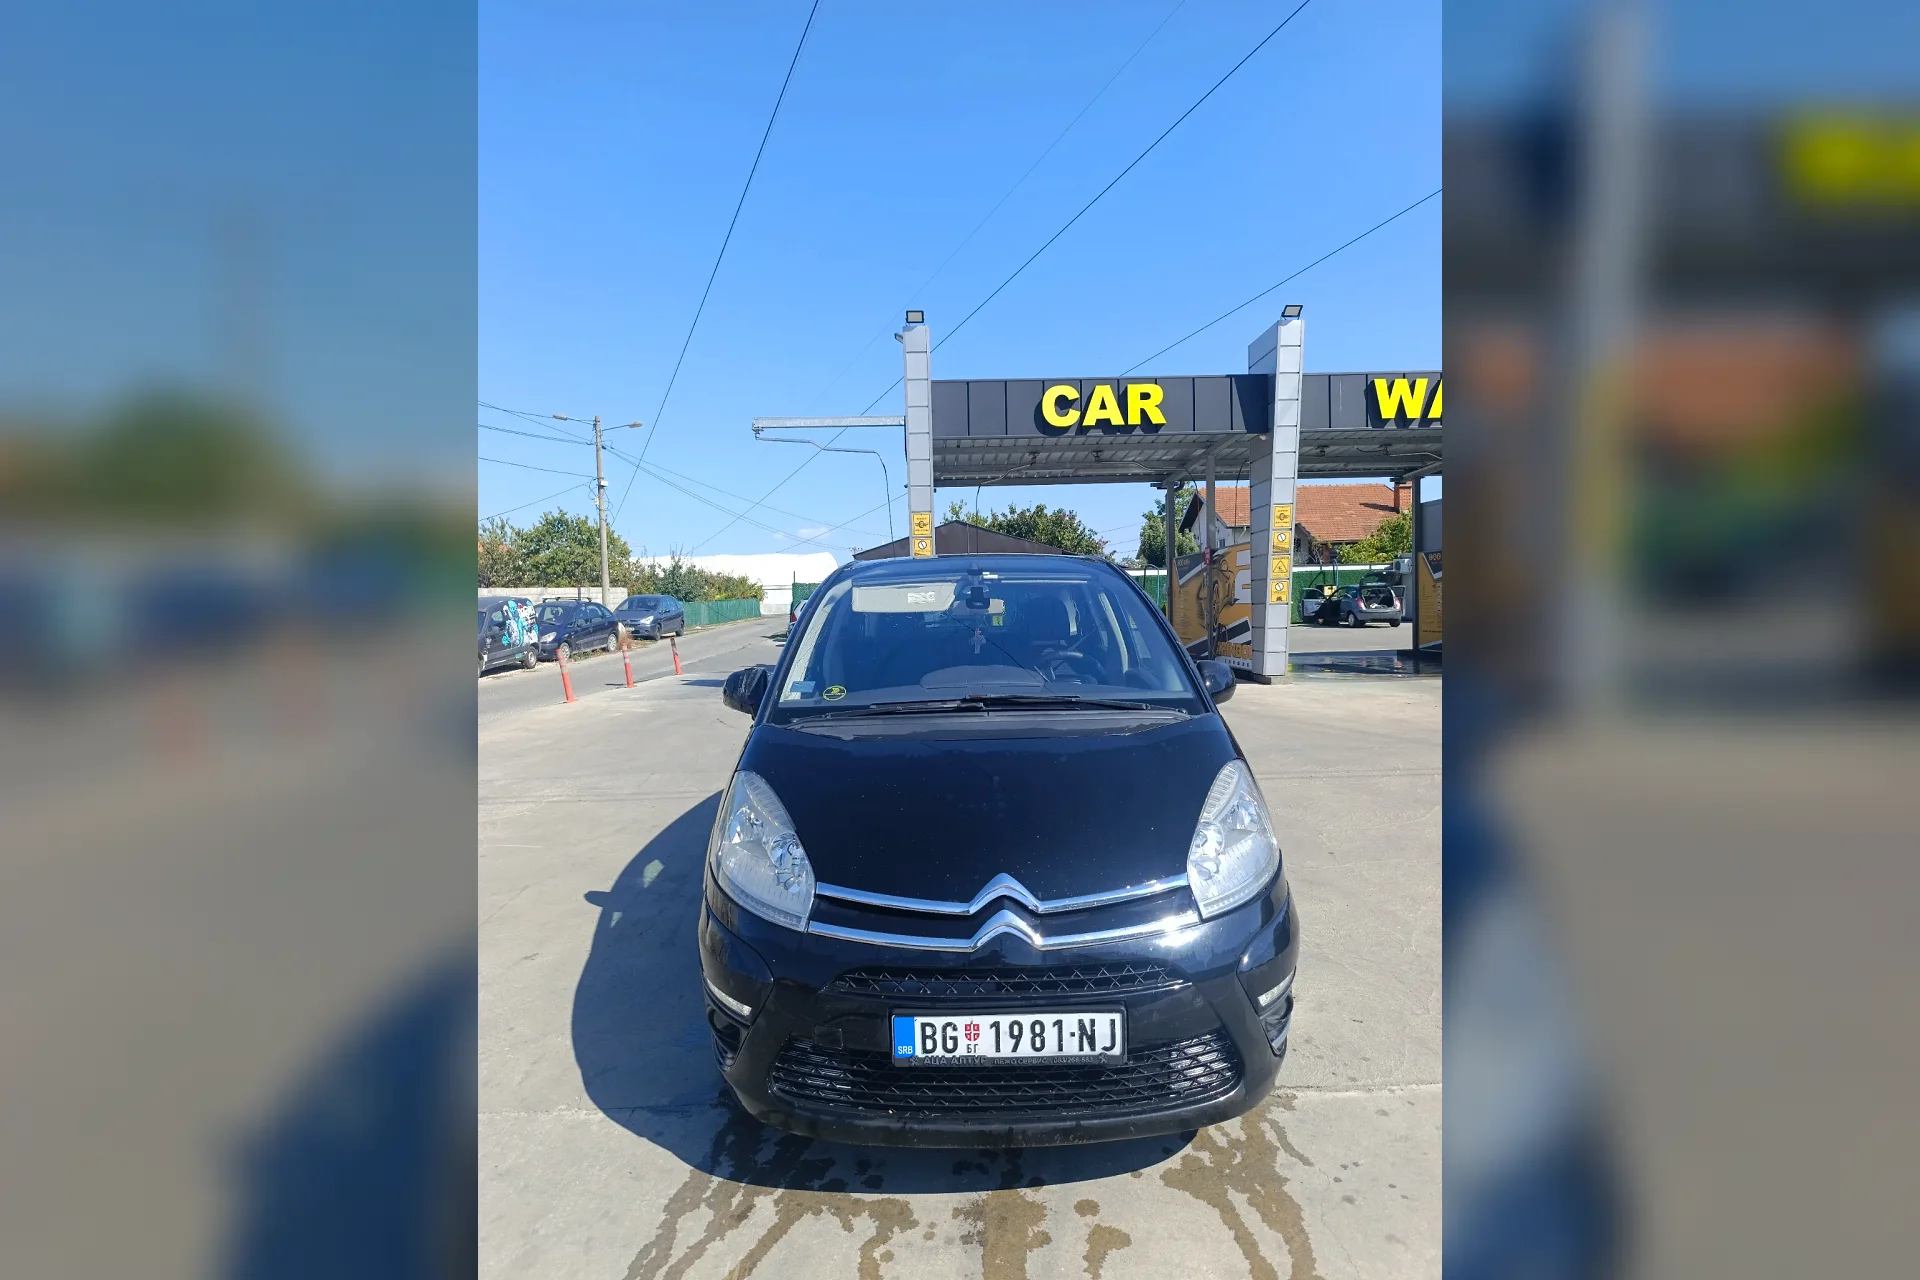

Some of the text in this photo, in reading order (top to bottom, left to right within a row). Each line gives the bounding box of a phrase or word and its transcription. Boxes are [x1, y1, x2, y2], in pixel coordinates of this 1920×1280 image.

[1041, 383, 1167, 428] CAR
[897, 1045, 913, 1055] SRB
[920, 1021, 958, 1054] BG
